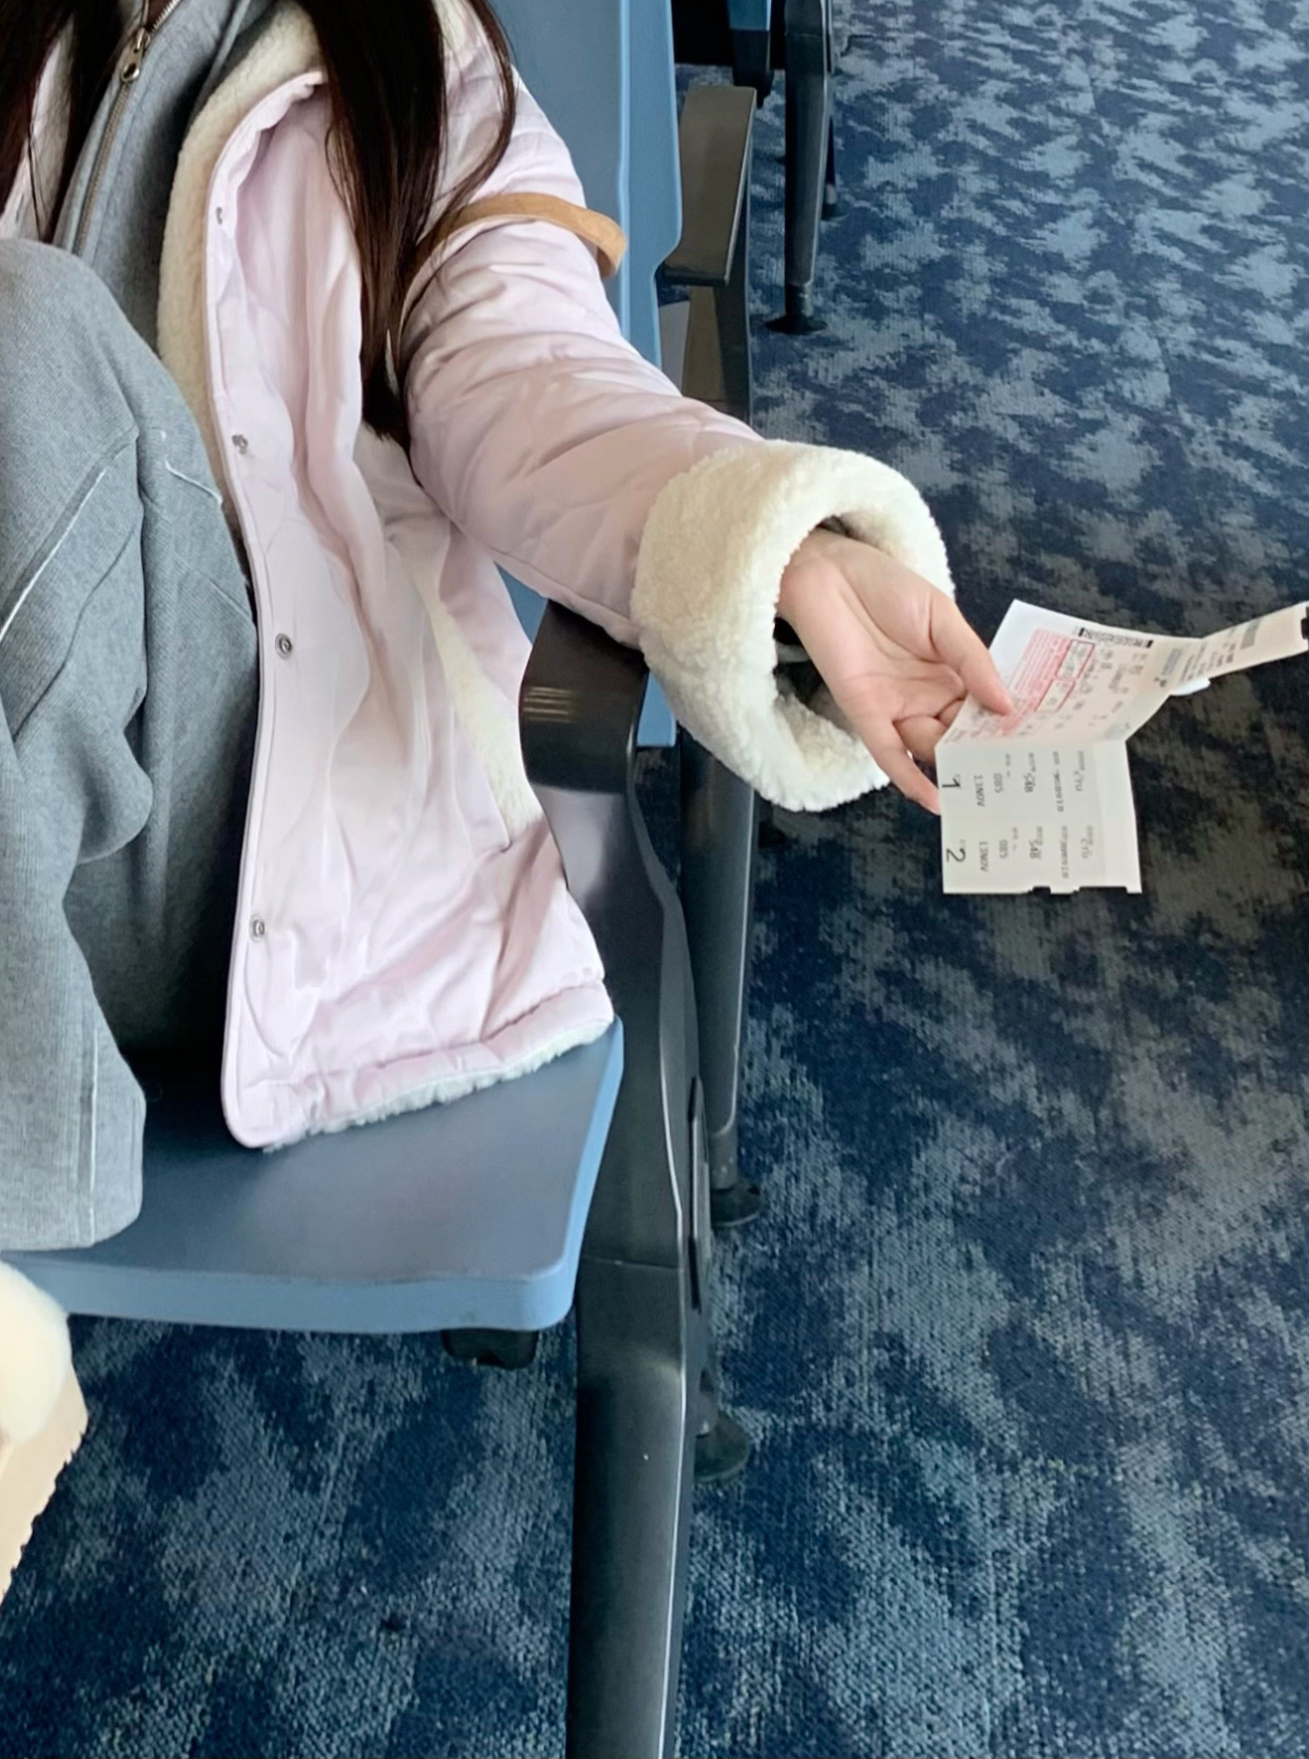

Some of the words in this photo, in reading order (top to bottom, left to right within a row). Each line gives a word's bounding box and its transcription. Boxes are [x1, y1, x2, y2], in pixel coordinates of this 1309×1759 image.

[941, 777, 962, 789] 1
[973, 774, 986, 807] 13NOV
[945, 847, 967, 863] 2
[978, 841, 990, 873] 13NOV
